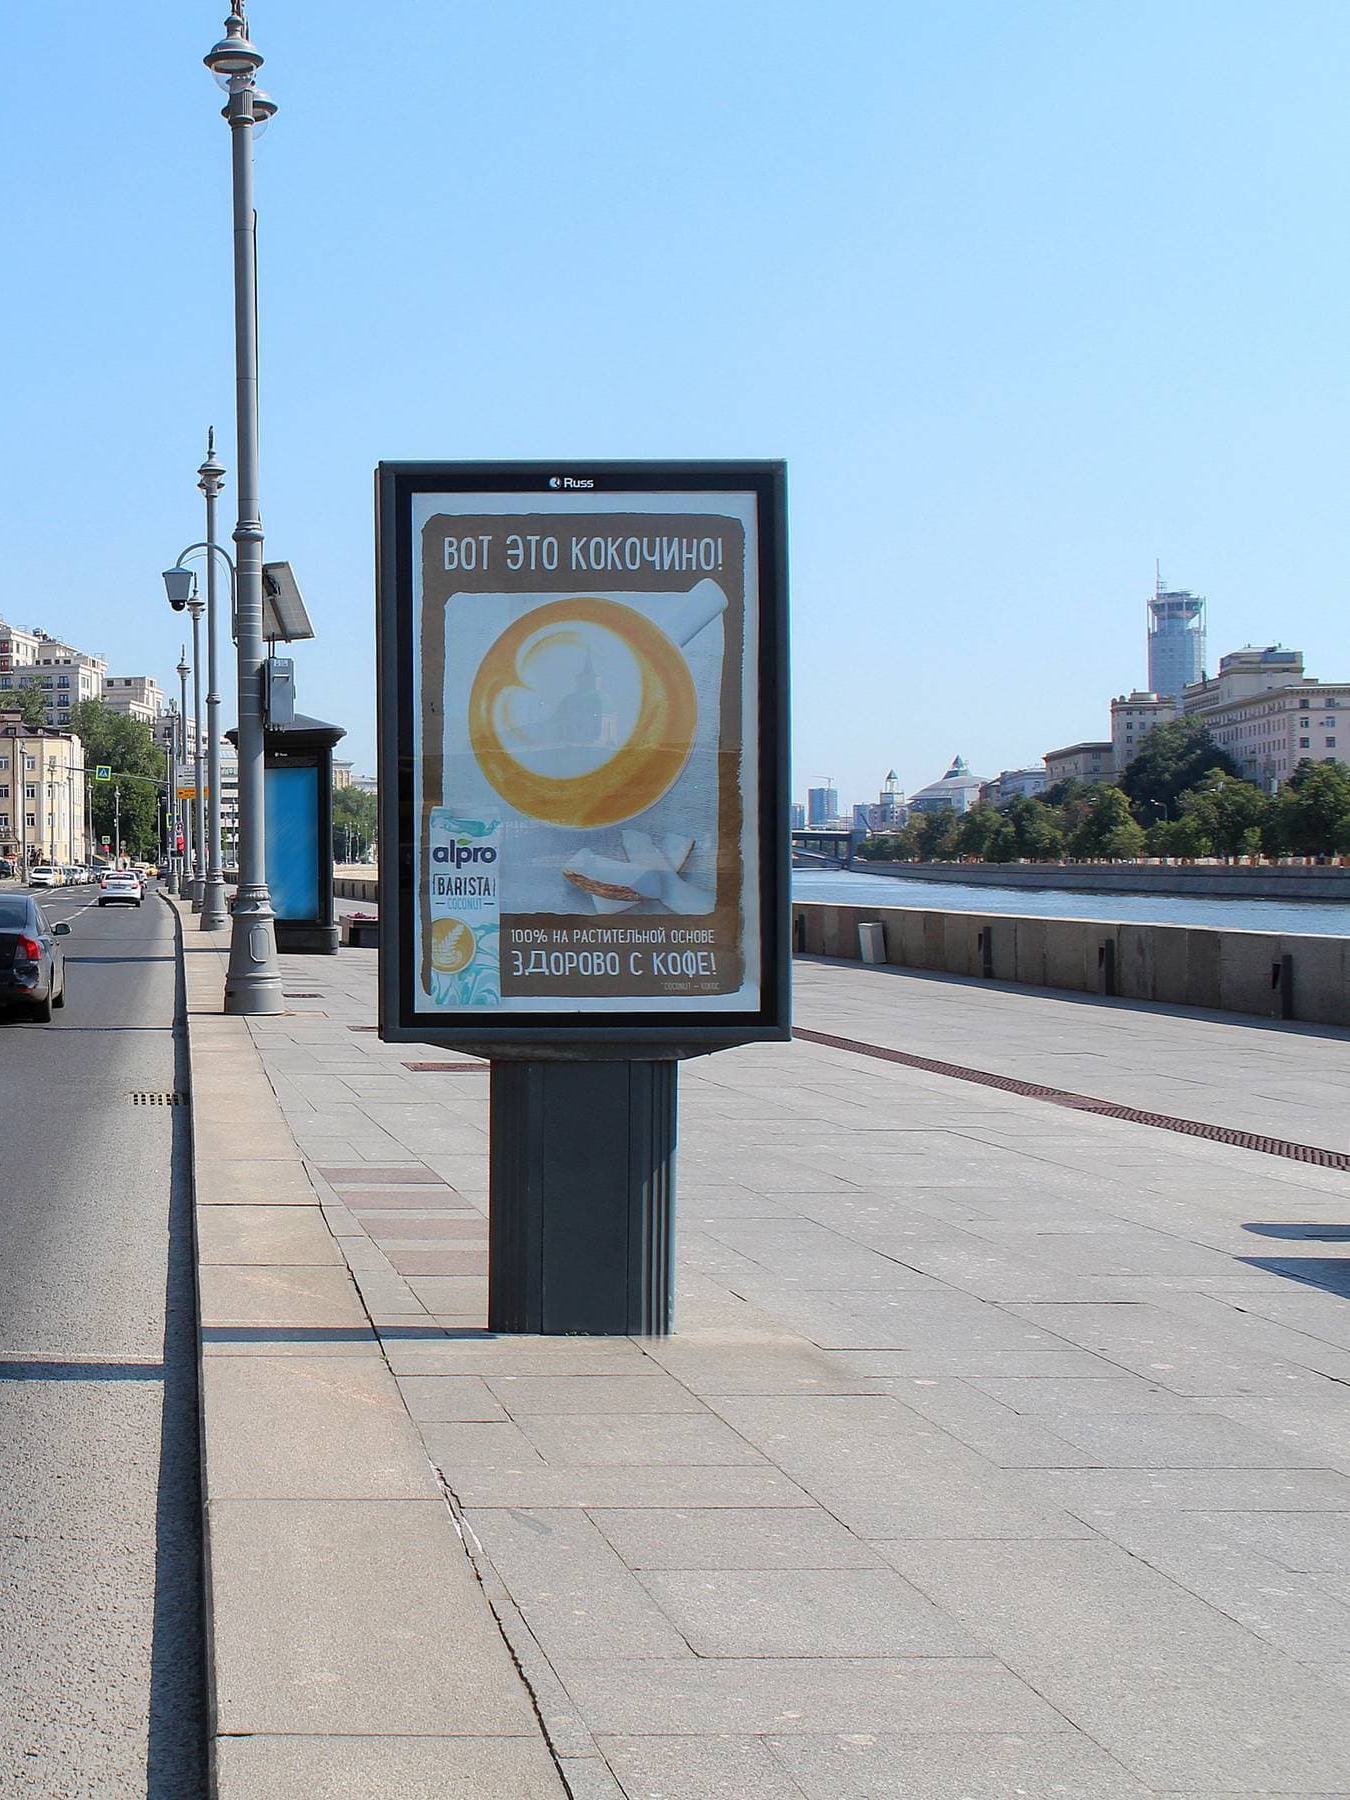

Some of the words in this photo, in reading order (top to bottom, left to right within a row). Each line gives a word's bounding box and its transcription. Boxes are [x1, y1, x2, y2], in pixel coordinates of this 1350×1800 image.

[564, 477, 594, 488] Russ
[444, 535, 492, 571] ВОТ
[506, 534, 559, 571] ЭТО
[571, 536, 723, 571] КОКОЧИНО!
[433, 839, 497, 869] alpro
[437, 876, 491, 896] BARISTA
[447, 898, 483, 910] COCONUT
[511, 929, 548, 943] 100%
[553, 929, 569, 943] НА
[573, 927, 666, 944] РАСТИТЕЛЬНОЙ
[671, 929, 715, 944] ОСНОВЕ
[511, 951, 620, 976] ЗДОРОВО
[630, 952, 643, 976] С
[653, 951, 717, 978] КОФЕ!
